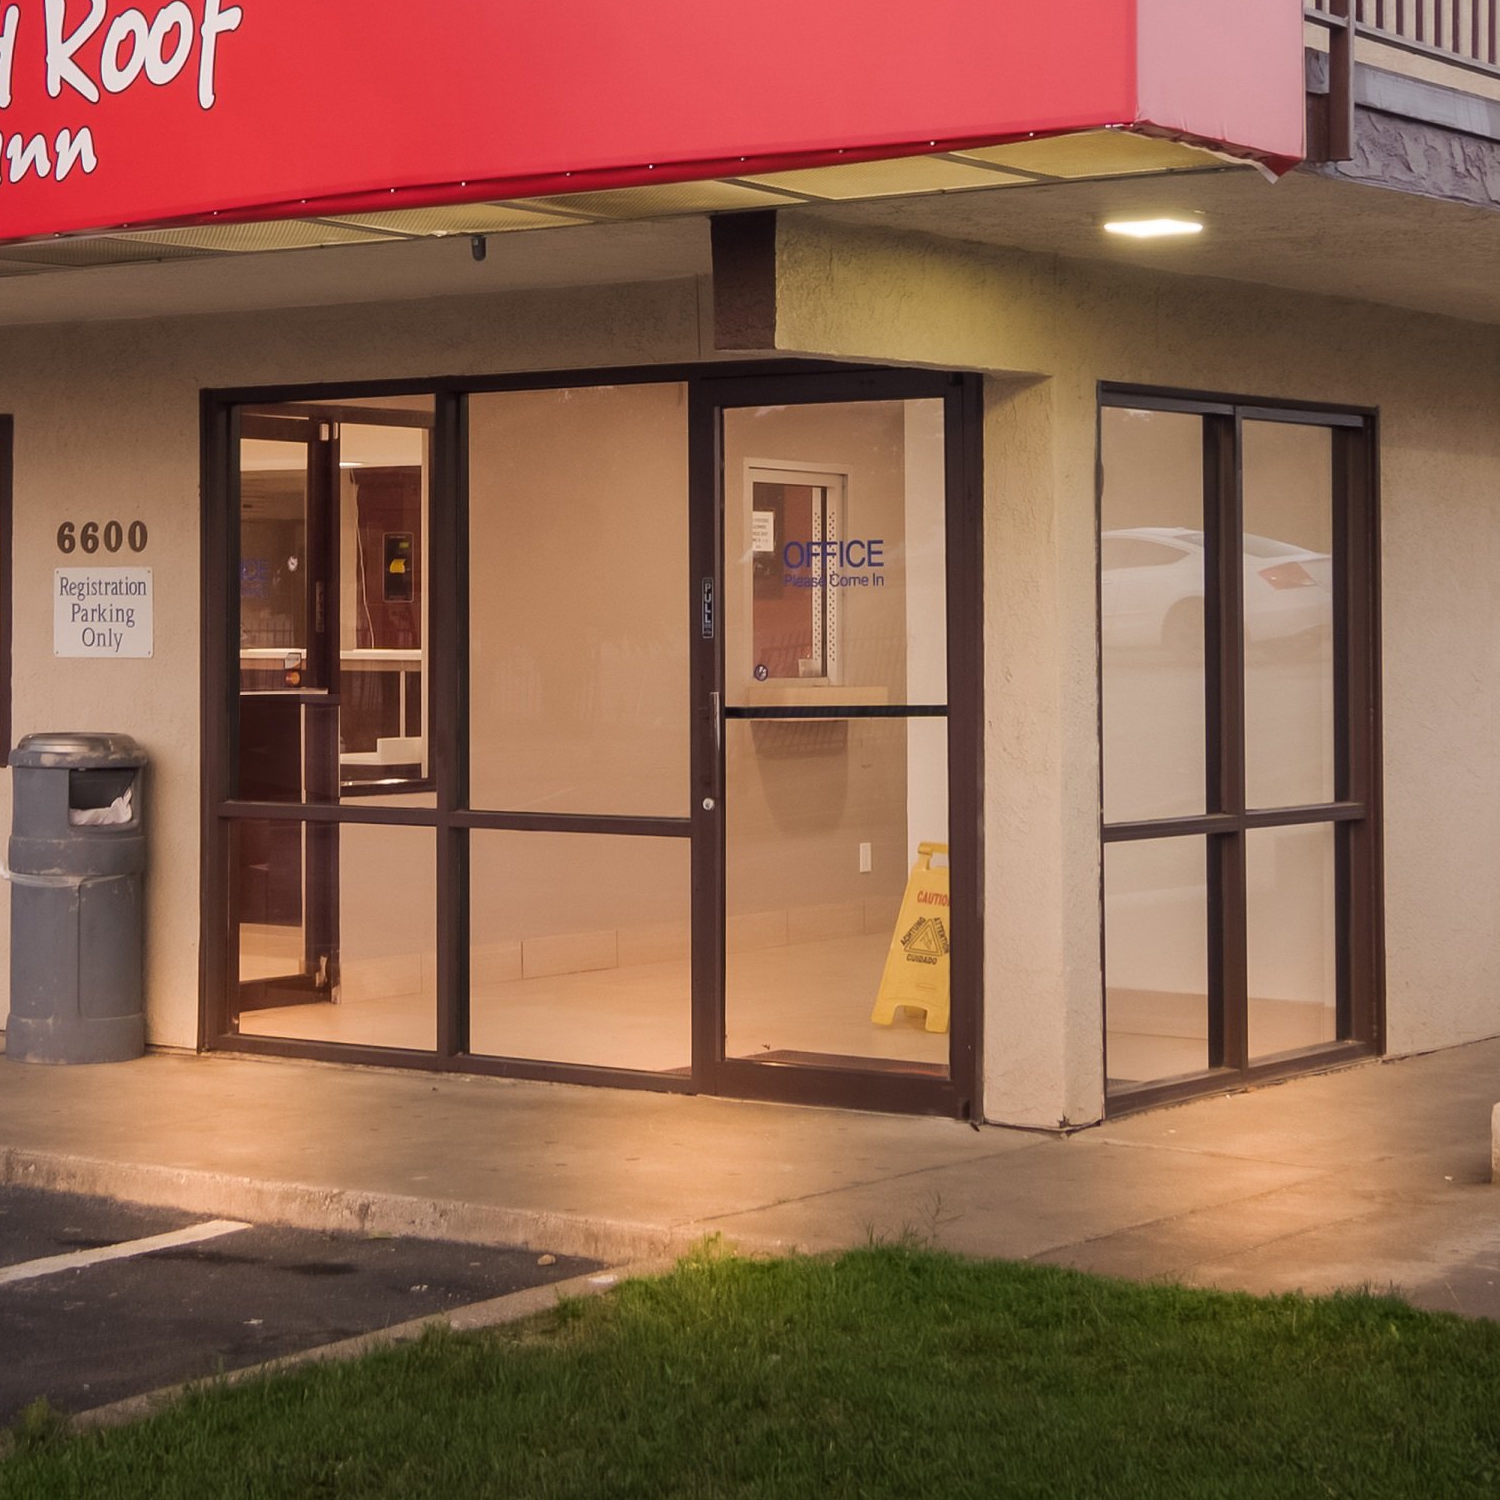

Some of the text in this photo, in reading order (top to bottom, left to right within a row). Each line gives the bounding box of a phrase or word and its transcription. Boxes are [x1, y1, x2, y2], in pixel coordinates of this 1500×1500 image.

[57, 521, 148, 554] 6600
[783, 539, 884, 569] OFFICE
[59, 576, 147, 601] Registration
[784, 573, 884, 588] Please Come In
[71, 603, 135, 628] Parking
[704, 583, 712, 624] PULL
[82, 627, 123, 652] Only
[917, 890, 950, 907] CAUTIO
[900, 916, 926, 946] ACHTUNG
[906, 954, 938, 965] CUIDADO
